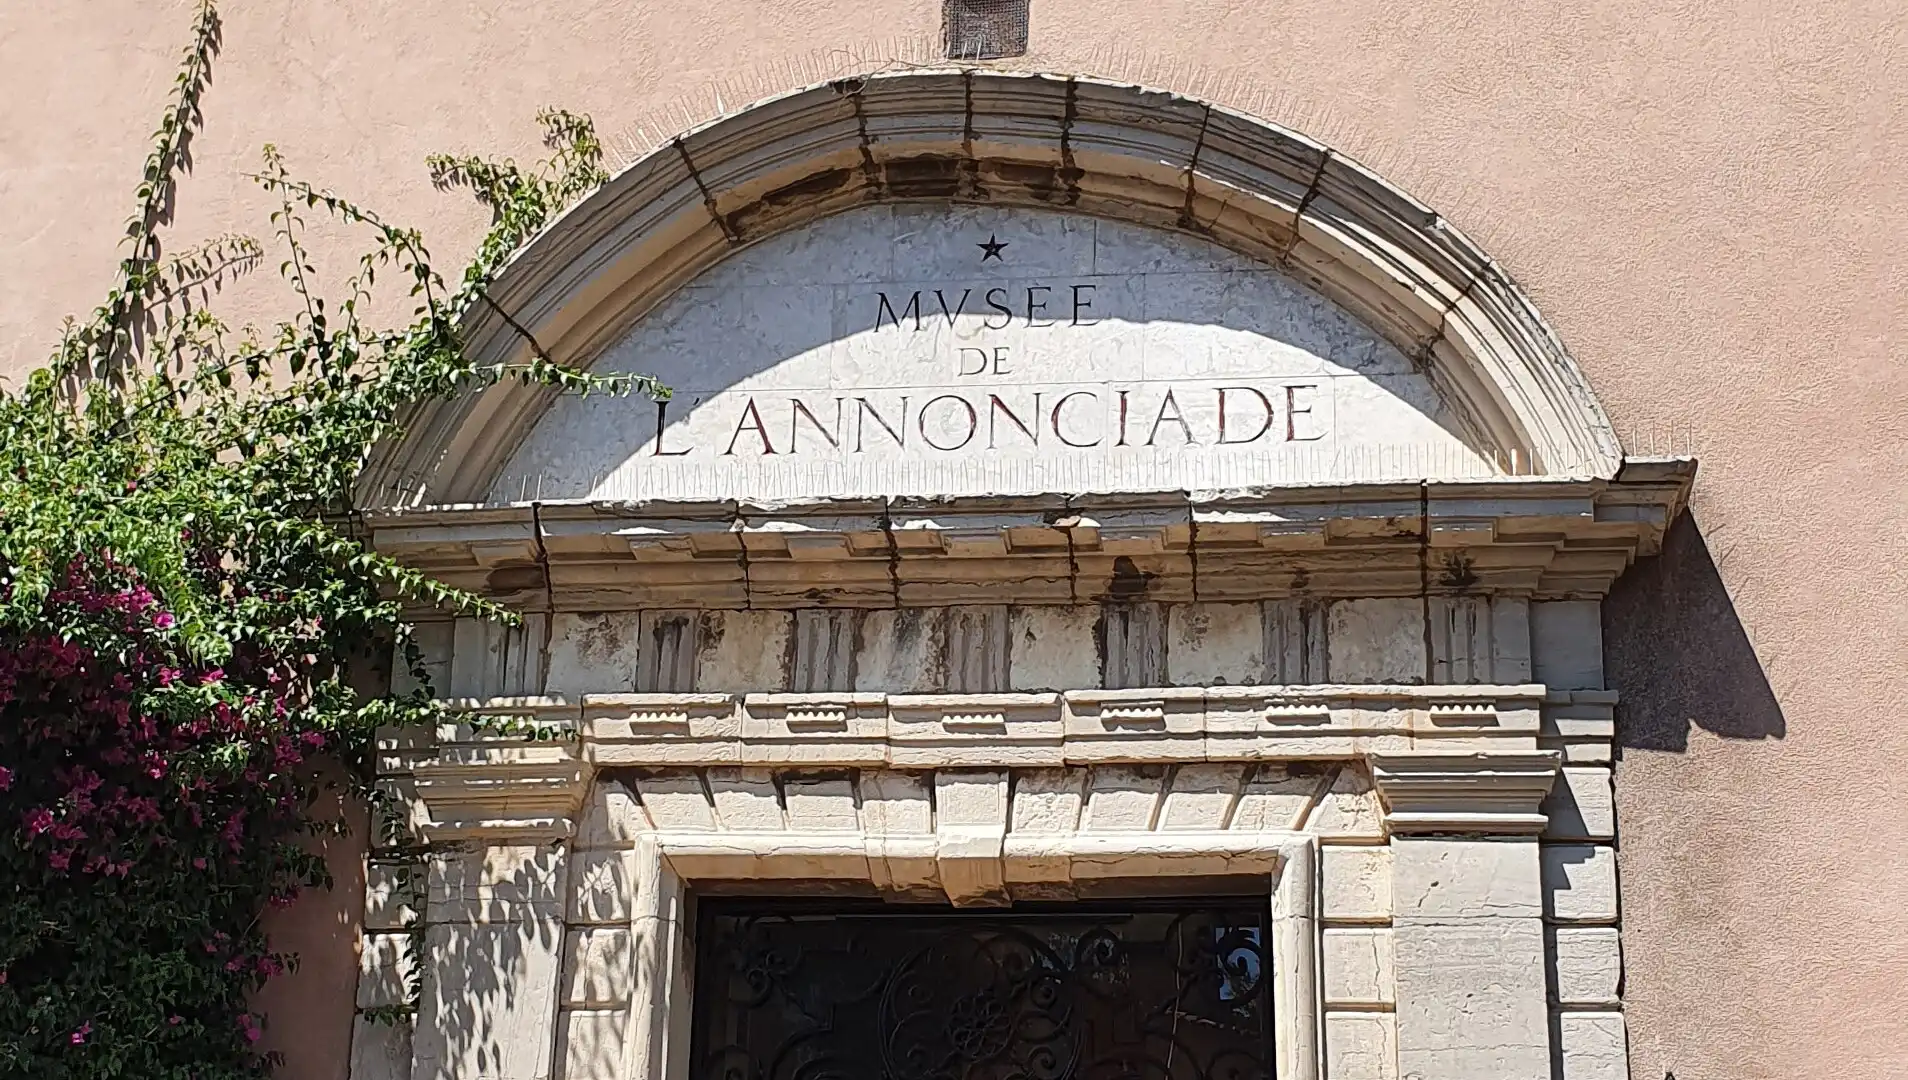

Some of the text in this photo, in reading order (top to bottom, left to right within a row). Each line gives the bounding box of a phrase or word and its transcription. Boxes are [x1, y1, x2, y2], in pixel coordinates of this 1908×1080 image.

[873, 284, 1100, 332] MVSEE
[957, 347, 1012, 376] DE
[650, 385, 1329, 456] L'ANNONCIADE
